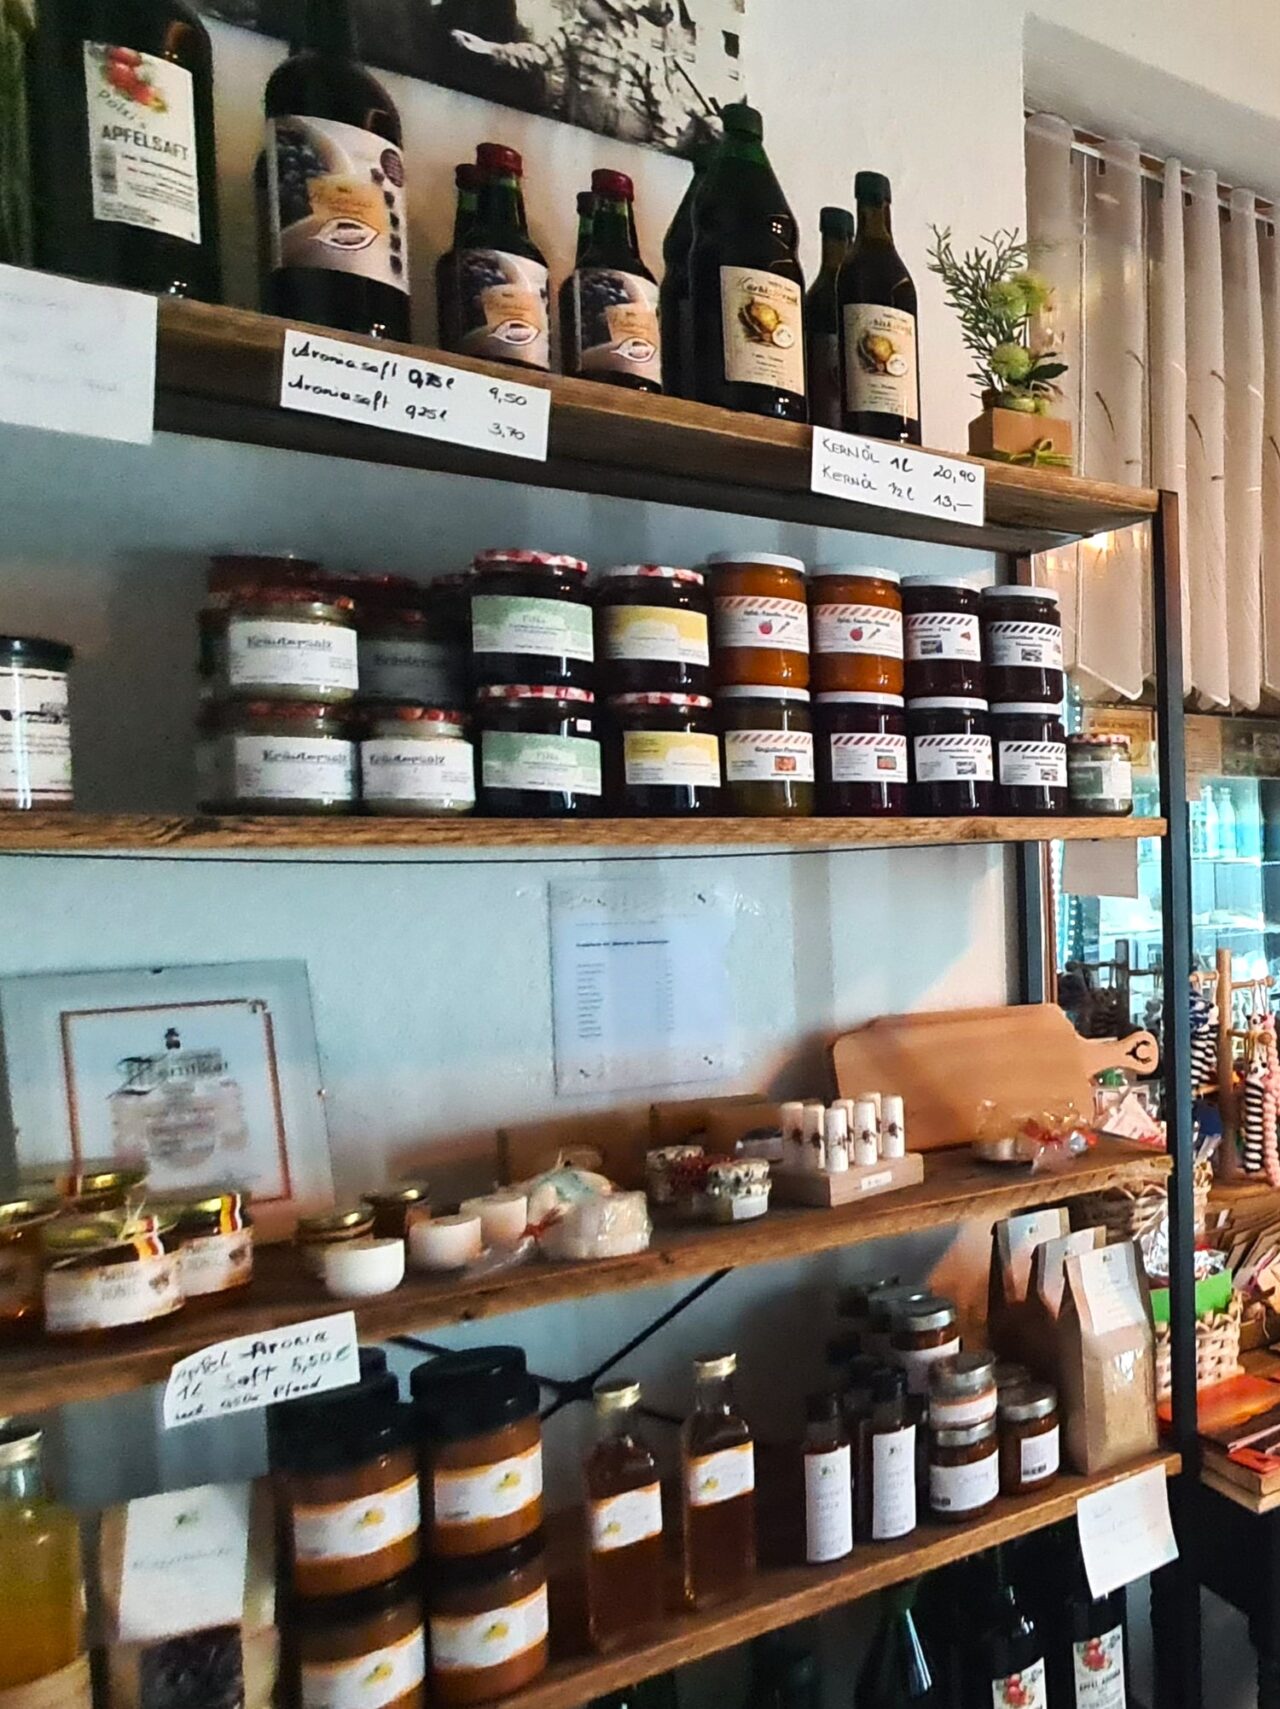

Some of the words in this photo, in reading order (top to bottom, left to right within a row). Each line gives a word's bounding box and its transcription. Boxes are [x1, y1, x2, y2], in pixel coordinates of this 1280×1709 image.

[101, 124, 189, 161] APFELSAFT
[287, 374, 388, 411] Aroniasaft
[488, 422, 526, 441] 3,70
[488, 386, 528, 406] 9,50
[822, 436, 880, 464] KERNÖL
[932, 464, 977, 484] 20,90
[822, 463, 878, 491] KERNÖL
